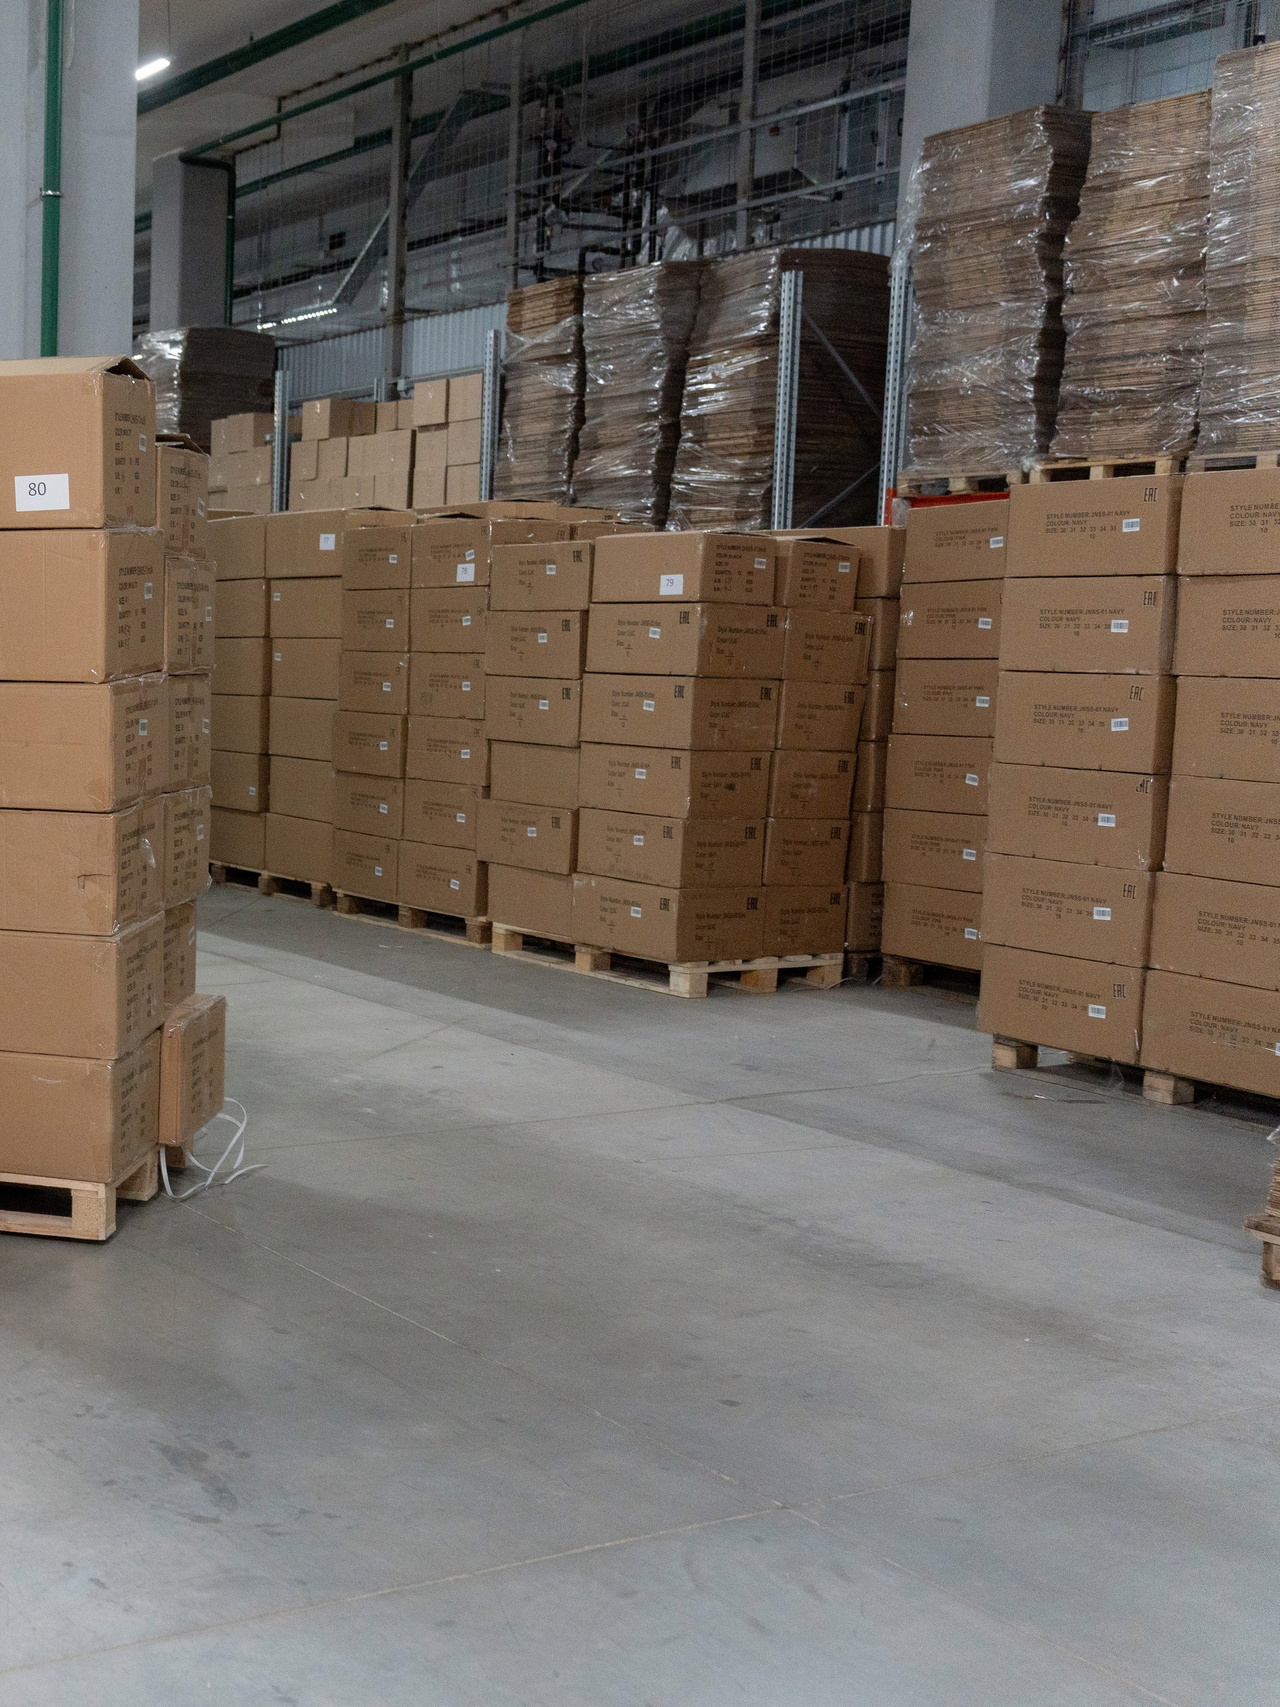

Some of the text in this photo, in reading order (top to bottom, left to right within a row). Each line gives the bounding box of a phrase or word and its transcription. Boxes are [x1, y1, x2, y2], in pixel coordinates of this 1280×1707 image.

[28, 482, 46, 496] 80
[1143, 487, 1158, 502] EAC
[666, 579, 674, 587] 79
[1143, 591, 1157, 605] EAC
[1129, 685, 1144, 701] EAC
[1211, 812, 1232, 820] STYLE
[1123, 883, 1136, 899] EAC
[1198, 911, 1219, 919] STYLE
[1228, 923, 1246, 931] NAVY
[1113, 983, 1126, 998] EAC
[1190, 1011, 1211, 1020] STYLE
[1220, 1025, 1238, 1033] NAVY
